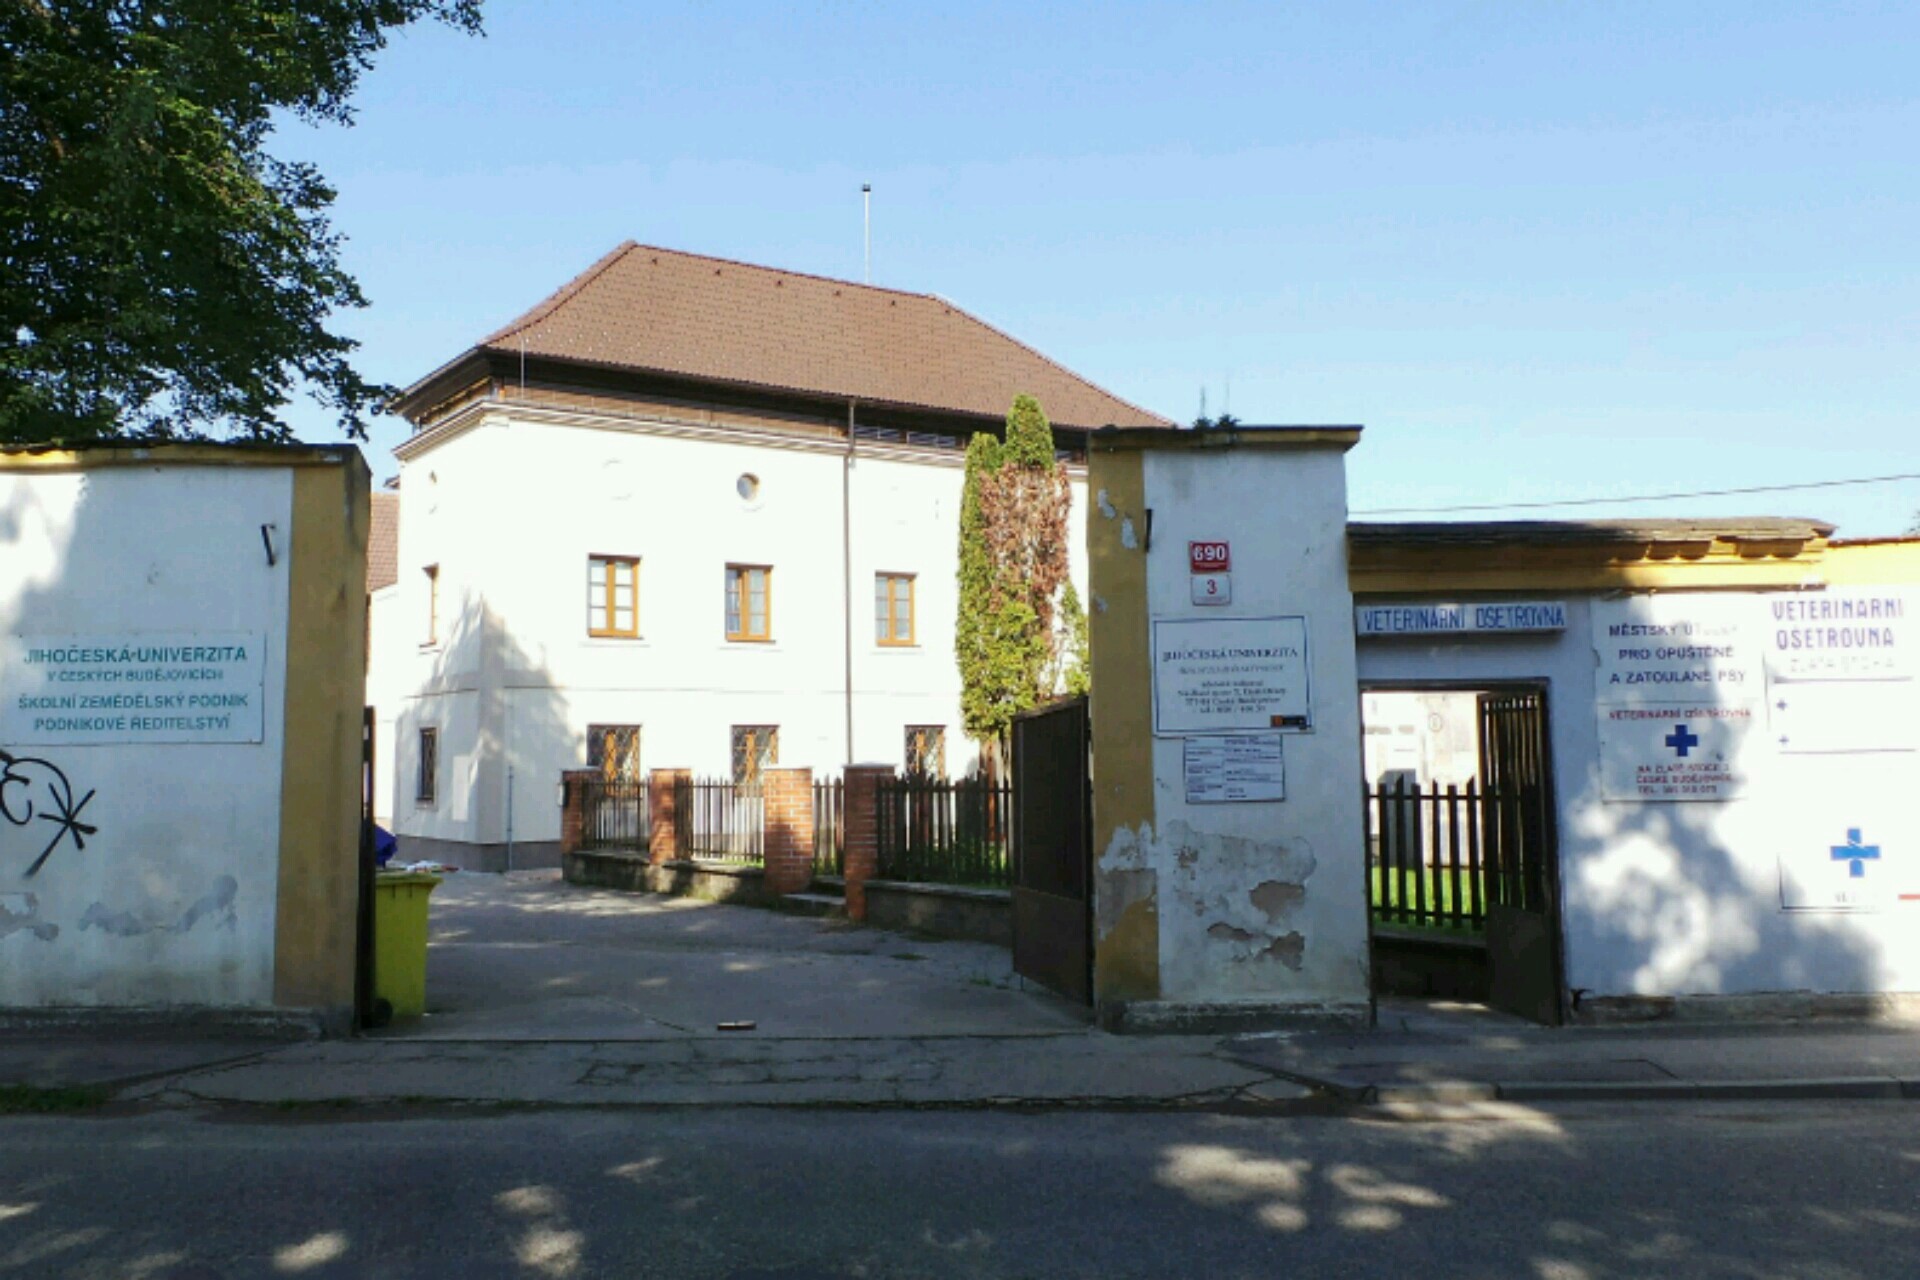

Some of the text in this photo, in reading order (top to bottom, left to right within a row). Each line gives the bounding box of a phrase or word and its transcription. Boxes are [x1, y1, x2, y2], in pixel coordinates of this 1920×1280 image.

[1193, 546, 1226, 562] 690
[1206, 579, 1217, 595] 3
[24, 644, 247, 664] JIHOČESKÁ UNIVERZITA
[1229, 647, 1298, 659] UNIVERZITA
[1618, 647, 1651, 660] PRO
[1609, 672, 1621, 684] A
[1718, 670, 1746, 683] PSY
[18, 693, 76, 709] ŠKOLNÍ
[188, 694, 248, 708] PODNIK
[33, 715, 125, 731] PODNIKOVÉ
